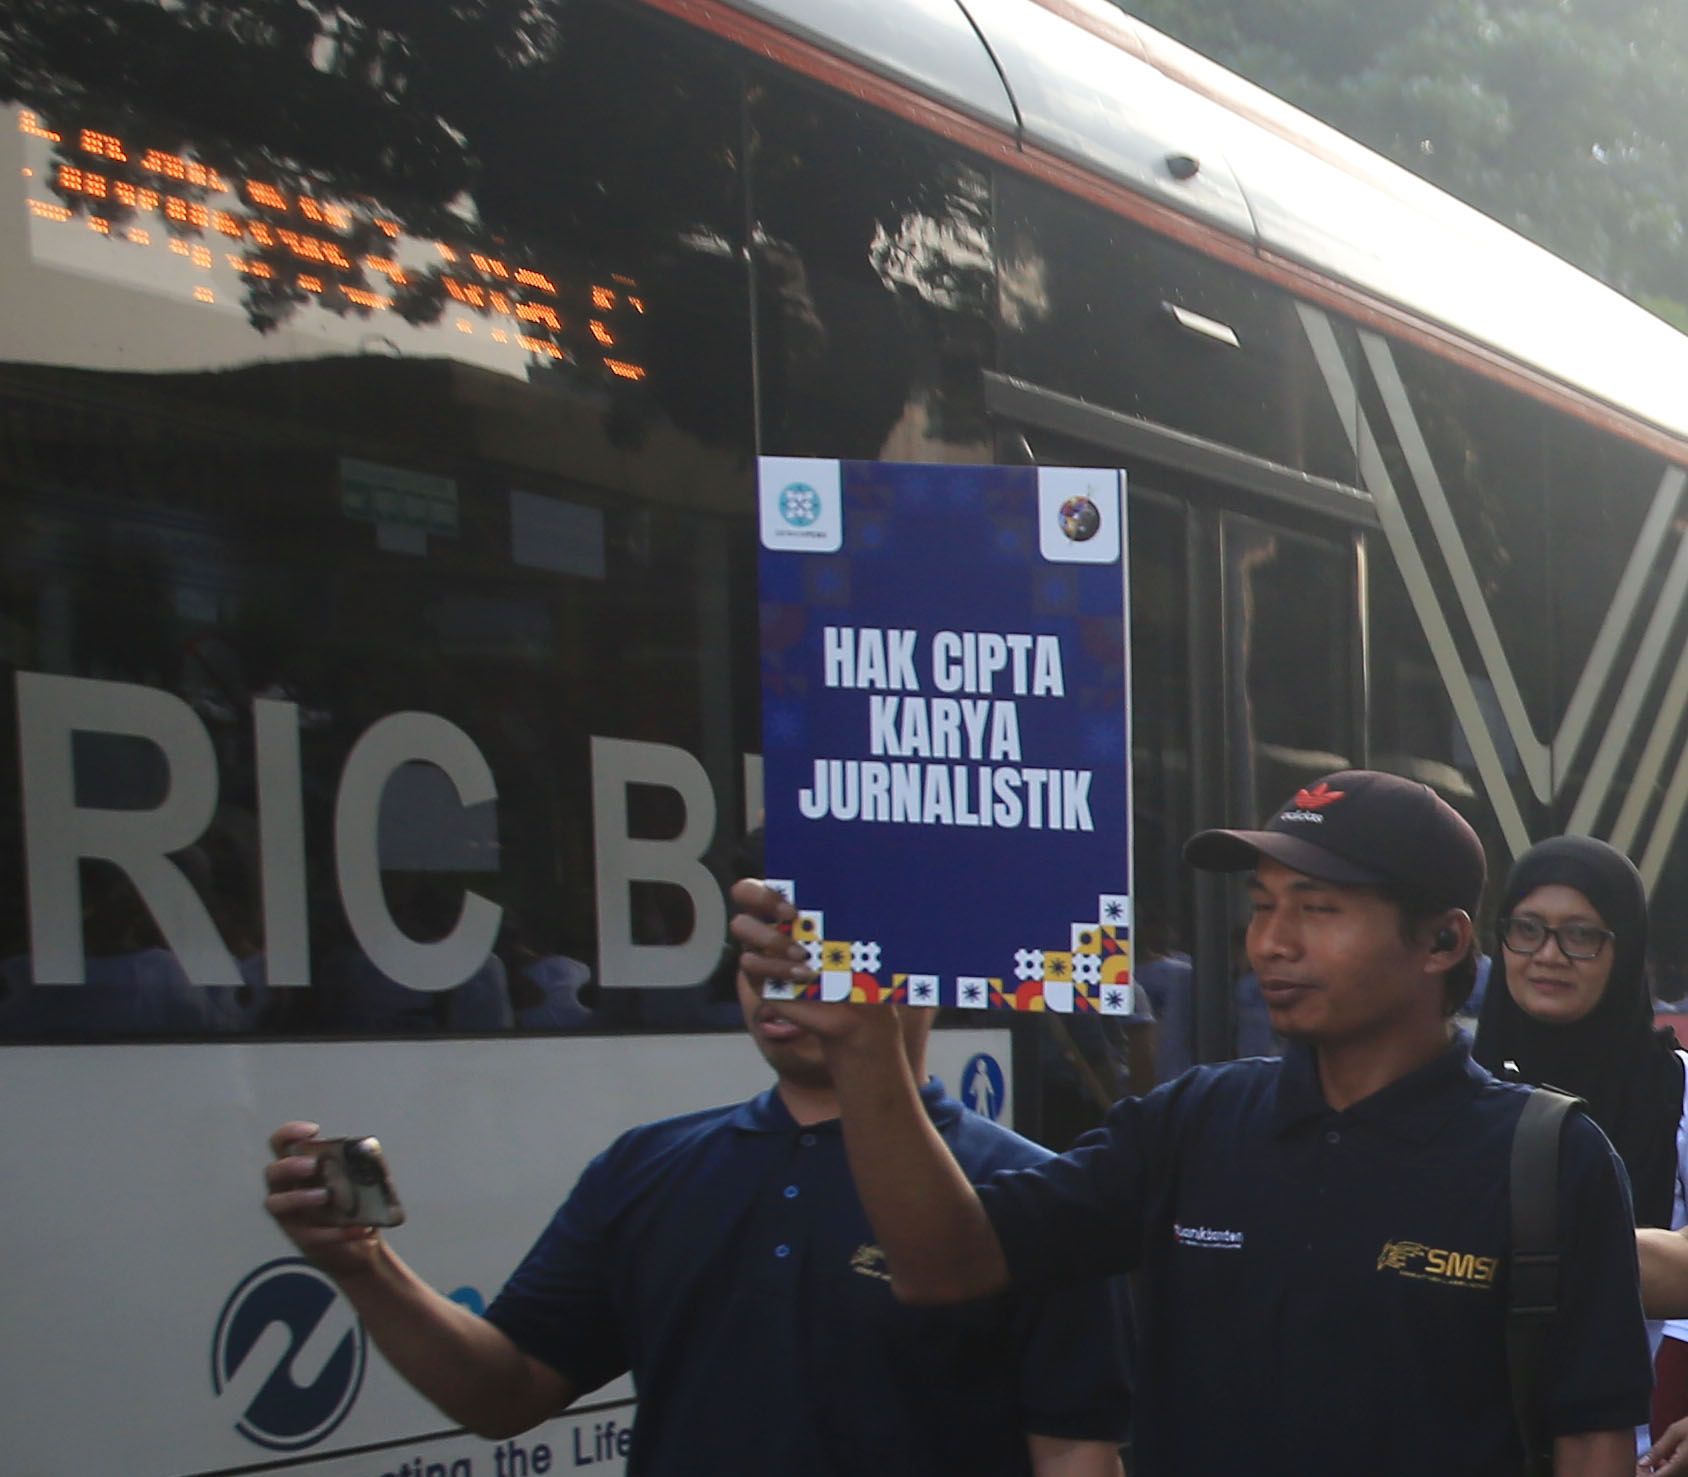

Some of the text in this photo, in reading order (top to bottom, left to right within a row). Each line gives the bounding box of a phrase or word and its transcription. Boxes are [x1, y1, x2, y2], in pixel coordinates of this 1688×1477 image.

[824, 626, 1065, 698] HAK CIPTA
[869, 695, 1022, 762] KARYA
[799, 759, 1095, 831] JURNALISTIK
[1425, 1249, 1497, 1281] SMSI
